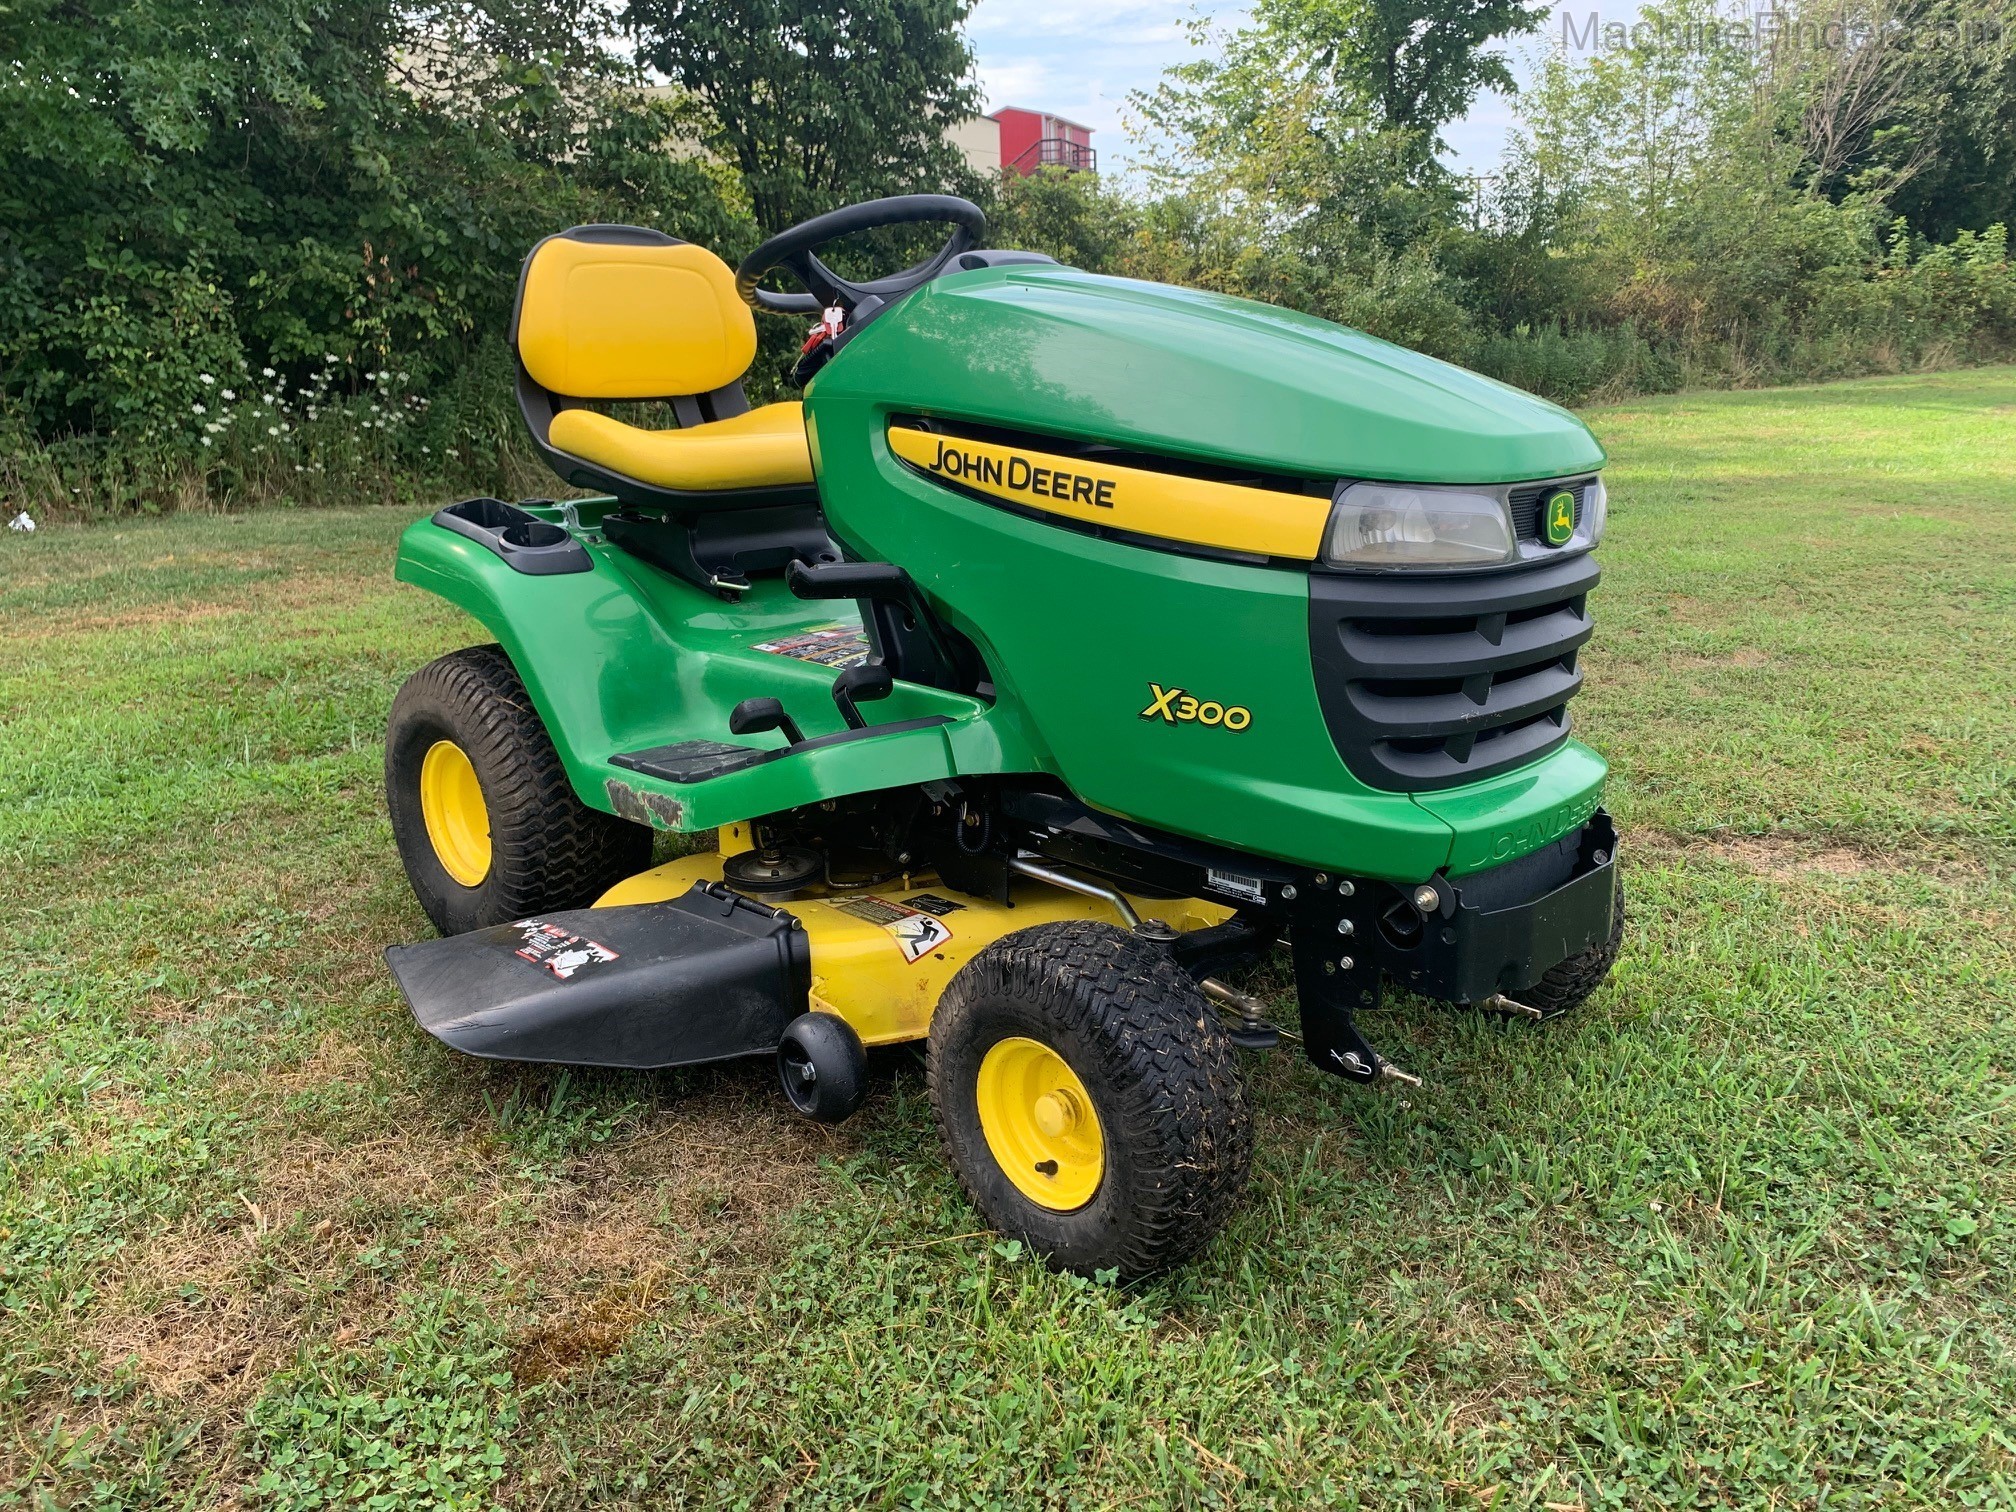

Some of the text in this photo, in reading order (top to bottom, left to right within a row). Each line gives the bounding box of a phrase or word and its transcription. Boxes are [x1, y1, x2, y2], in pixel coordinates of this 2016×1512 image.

[928, 440, 1117, 509] JOHN DEERE
[1138, 682, 1252, 733] X300
[1469, 816, 1551, 867] JOHN
